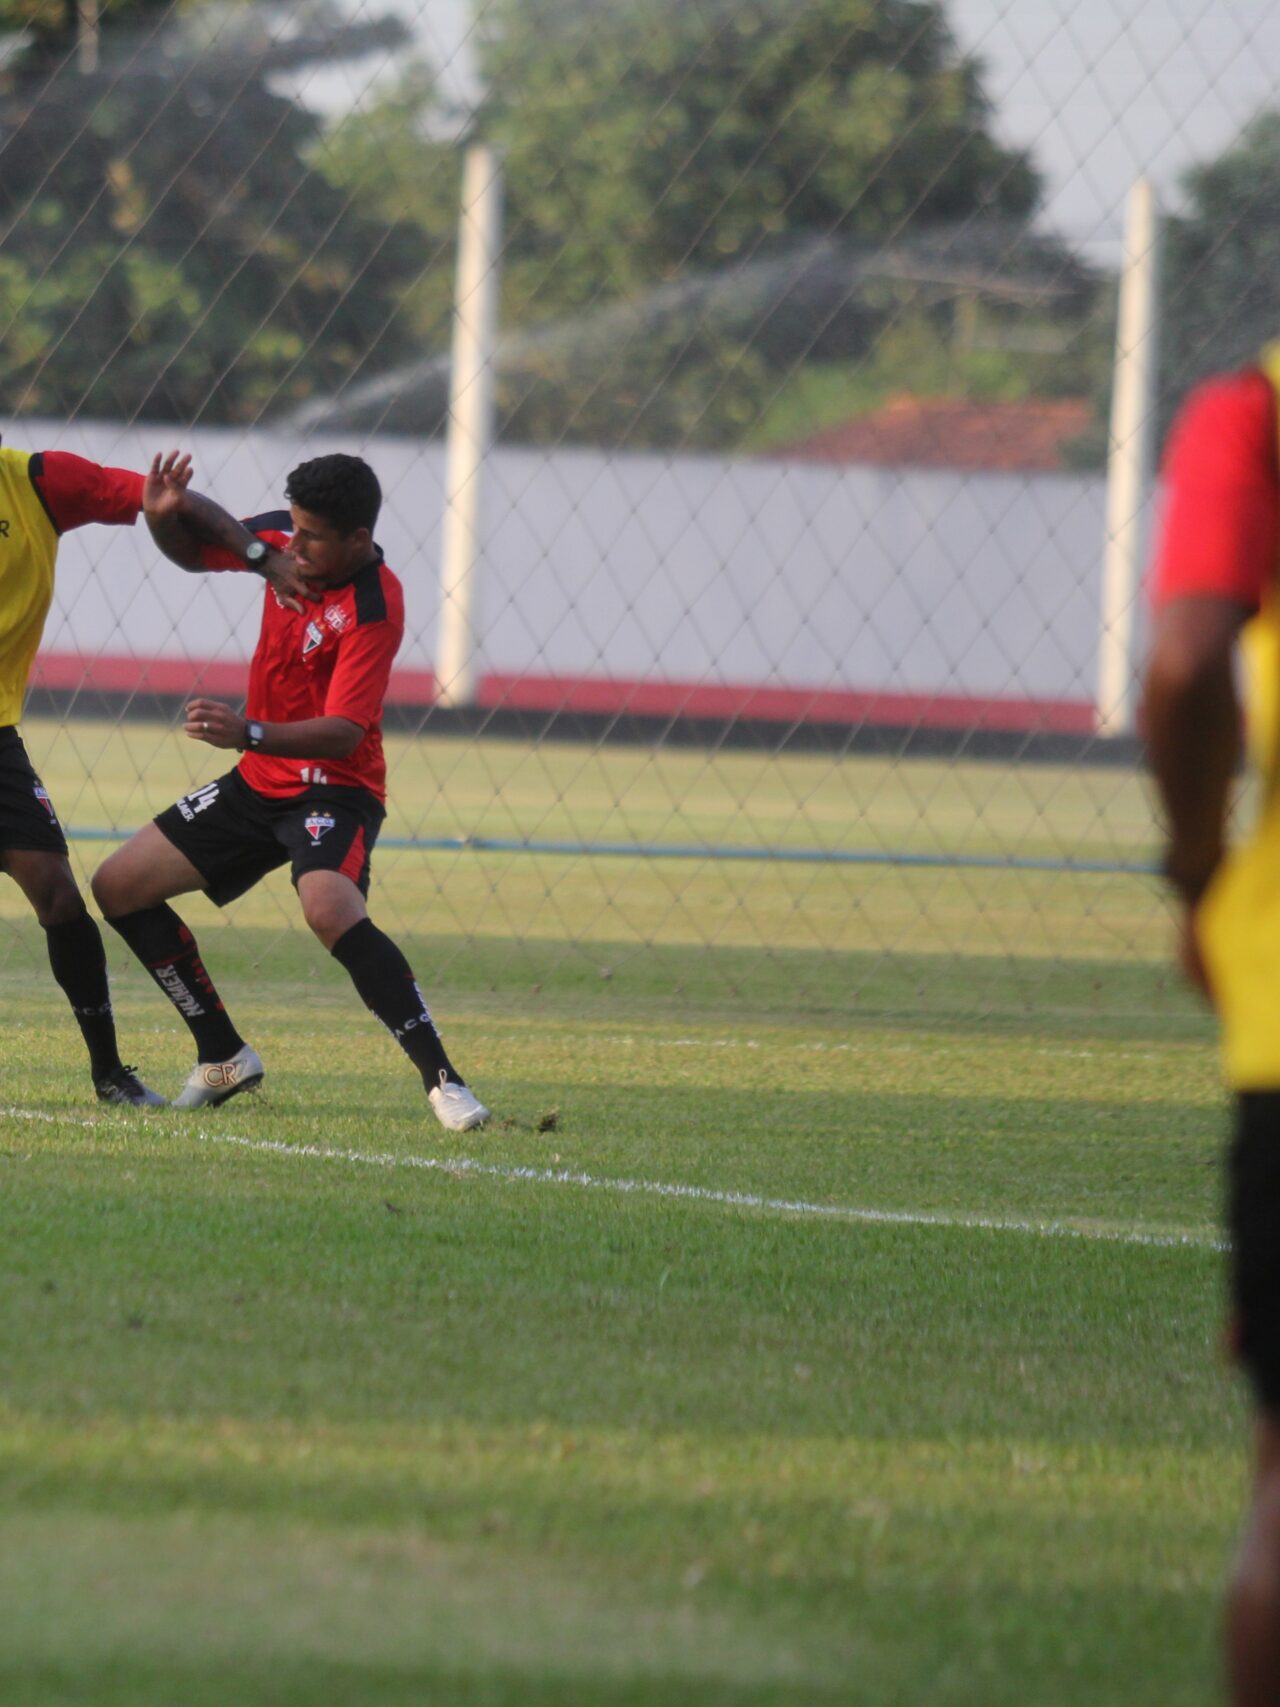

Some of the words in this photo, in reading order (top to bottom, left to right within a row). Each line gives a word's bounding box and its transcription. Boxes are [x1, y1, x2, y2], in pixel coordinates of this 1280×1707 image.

[187, 783, 220, 813] 14
[155, 964, 206, 1017] NUMER
[204, 1063, 237, 1088] CR
